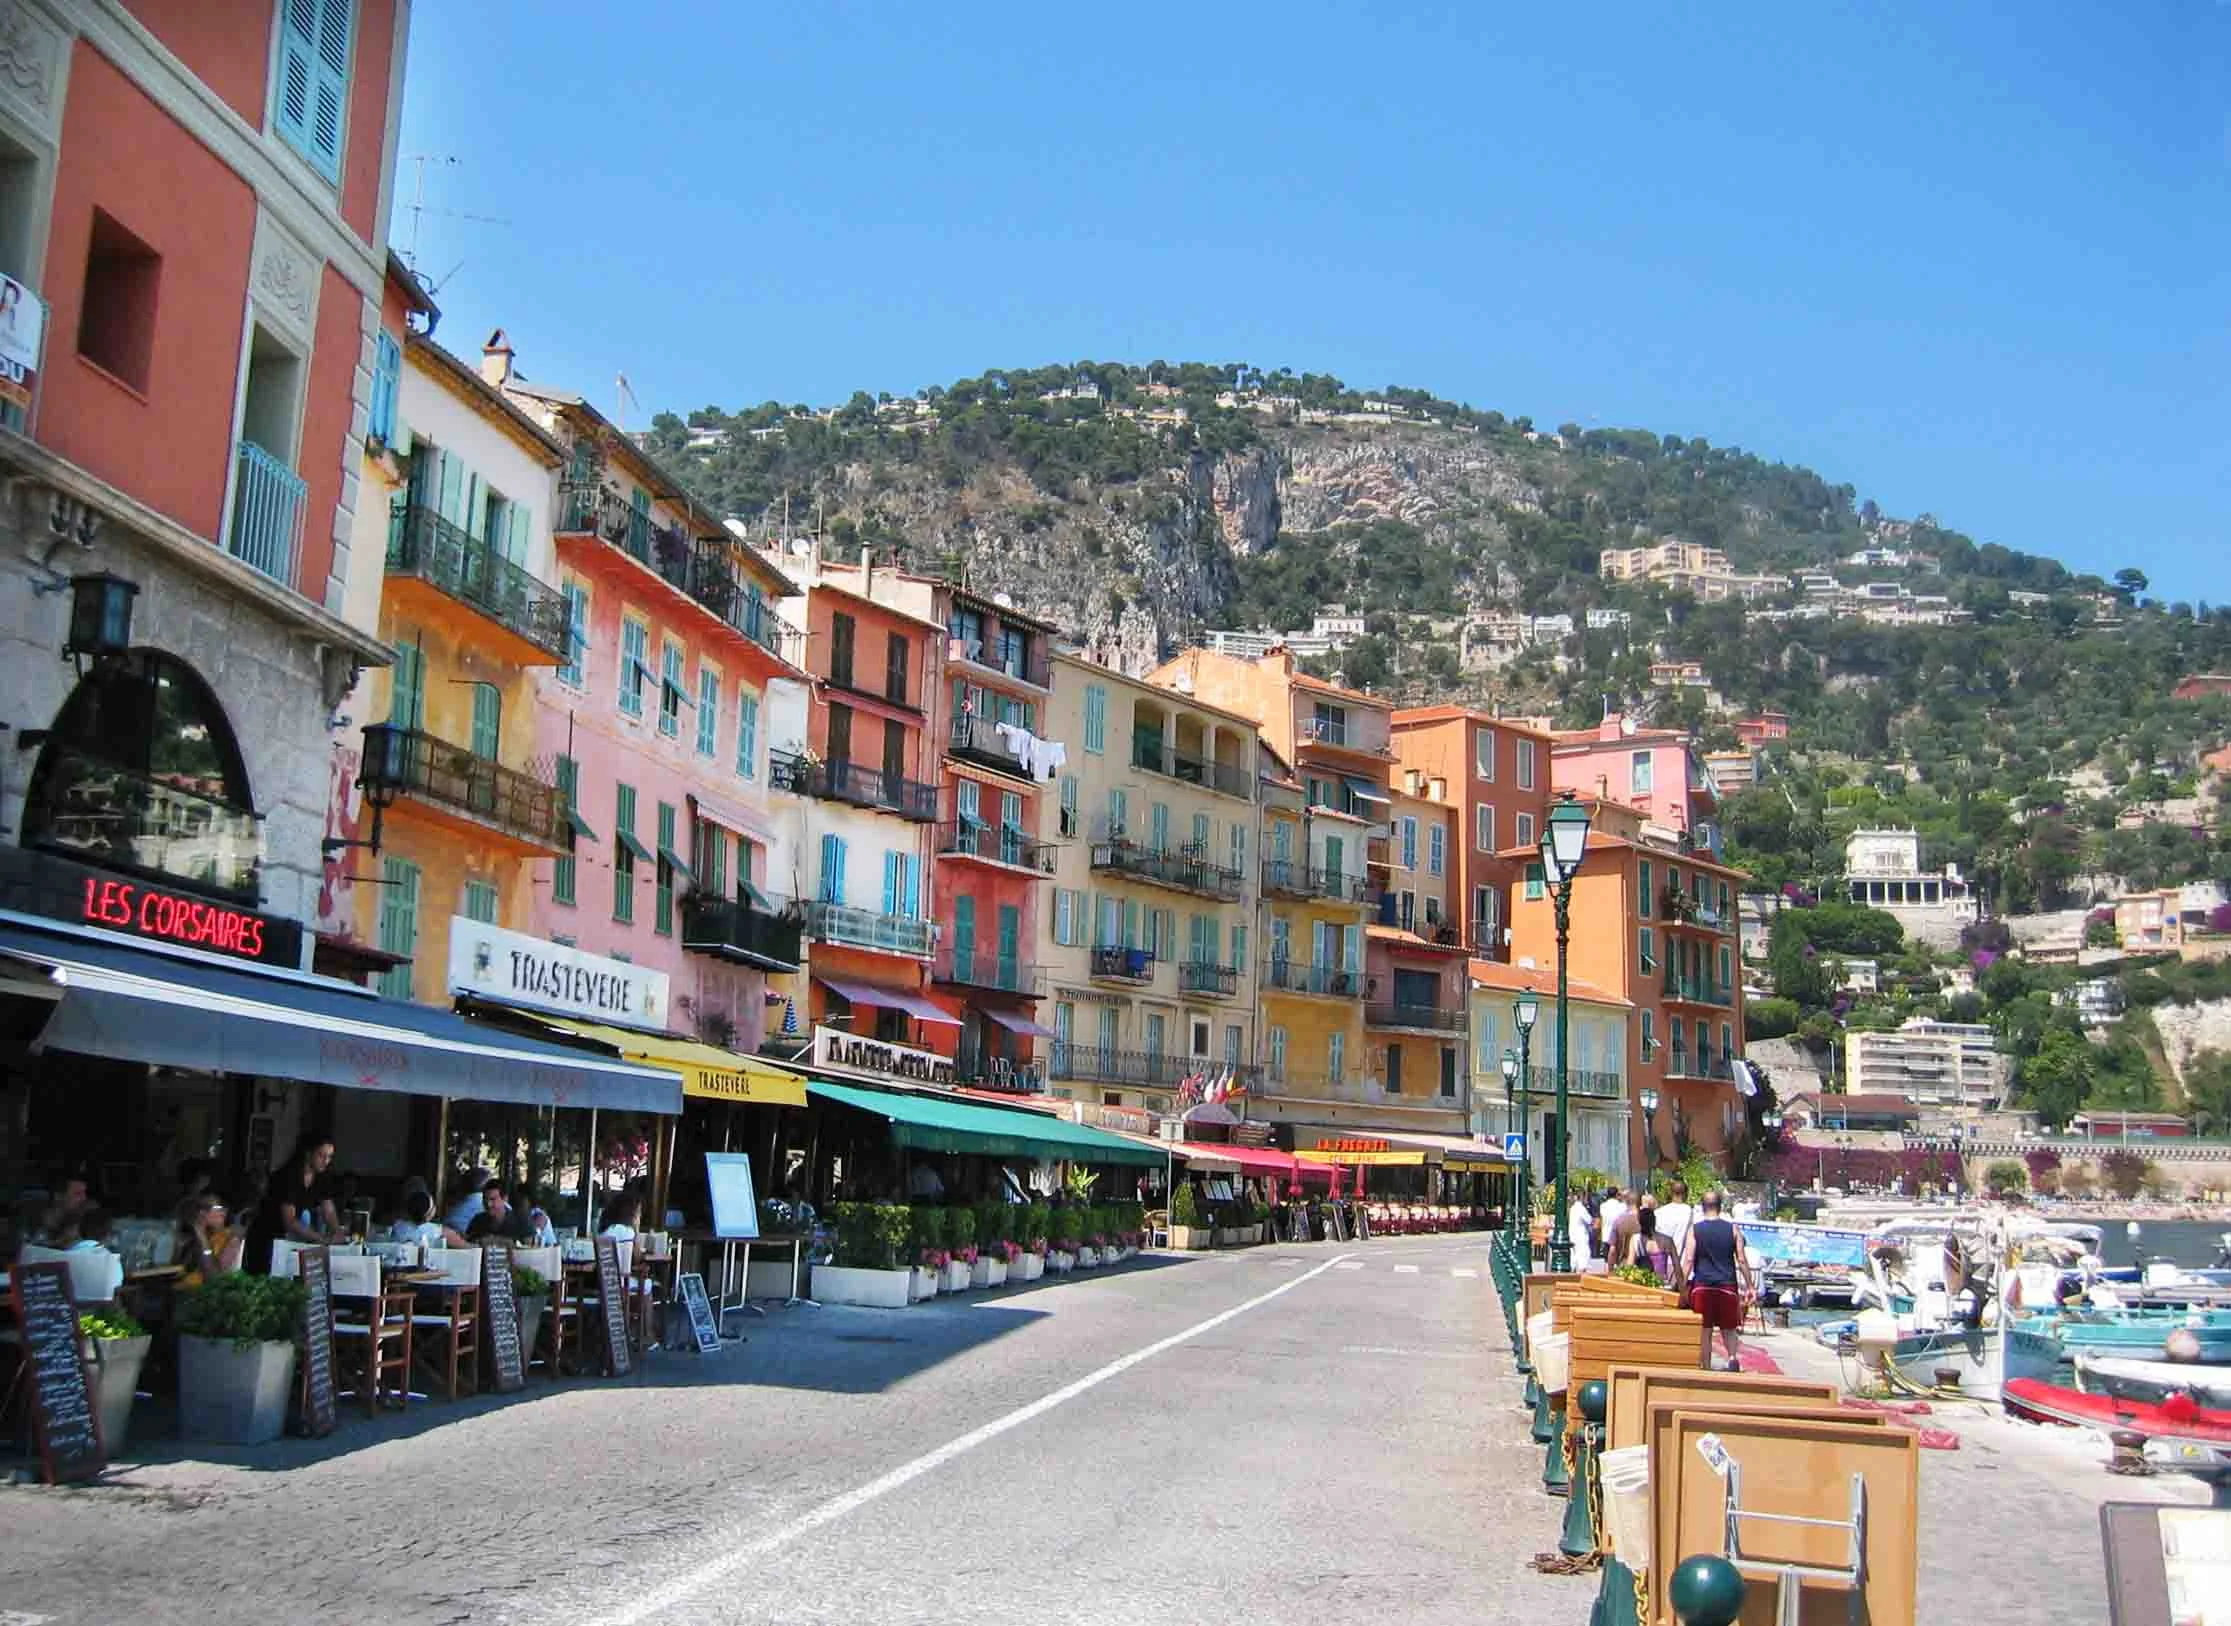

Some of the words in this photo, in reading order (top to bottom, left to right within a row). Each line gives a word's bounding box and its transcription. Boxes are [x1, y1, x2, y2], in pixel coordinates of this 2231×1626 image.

[84, 877, 135, 925] LES
[139, 891, 265, 957] CORSAIRES
[510, 949, 633, 1013] TRASTEVERE
[698, 1070, 751, 1096] TRASTEVERE
